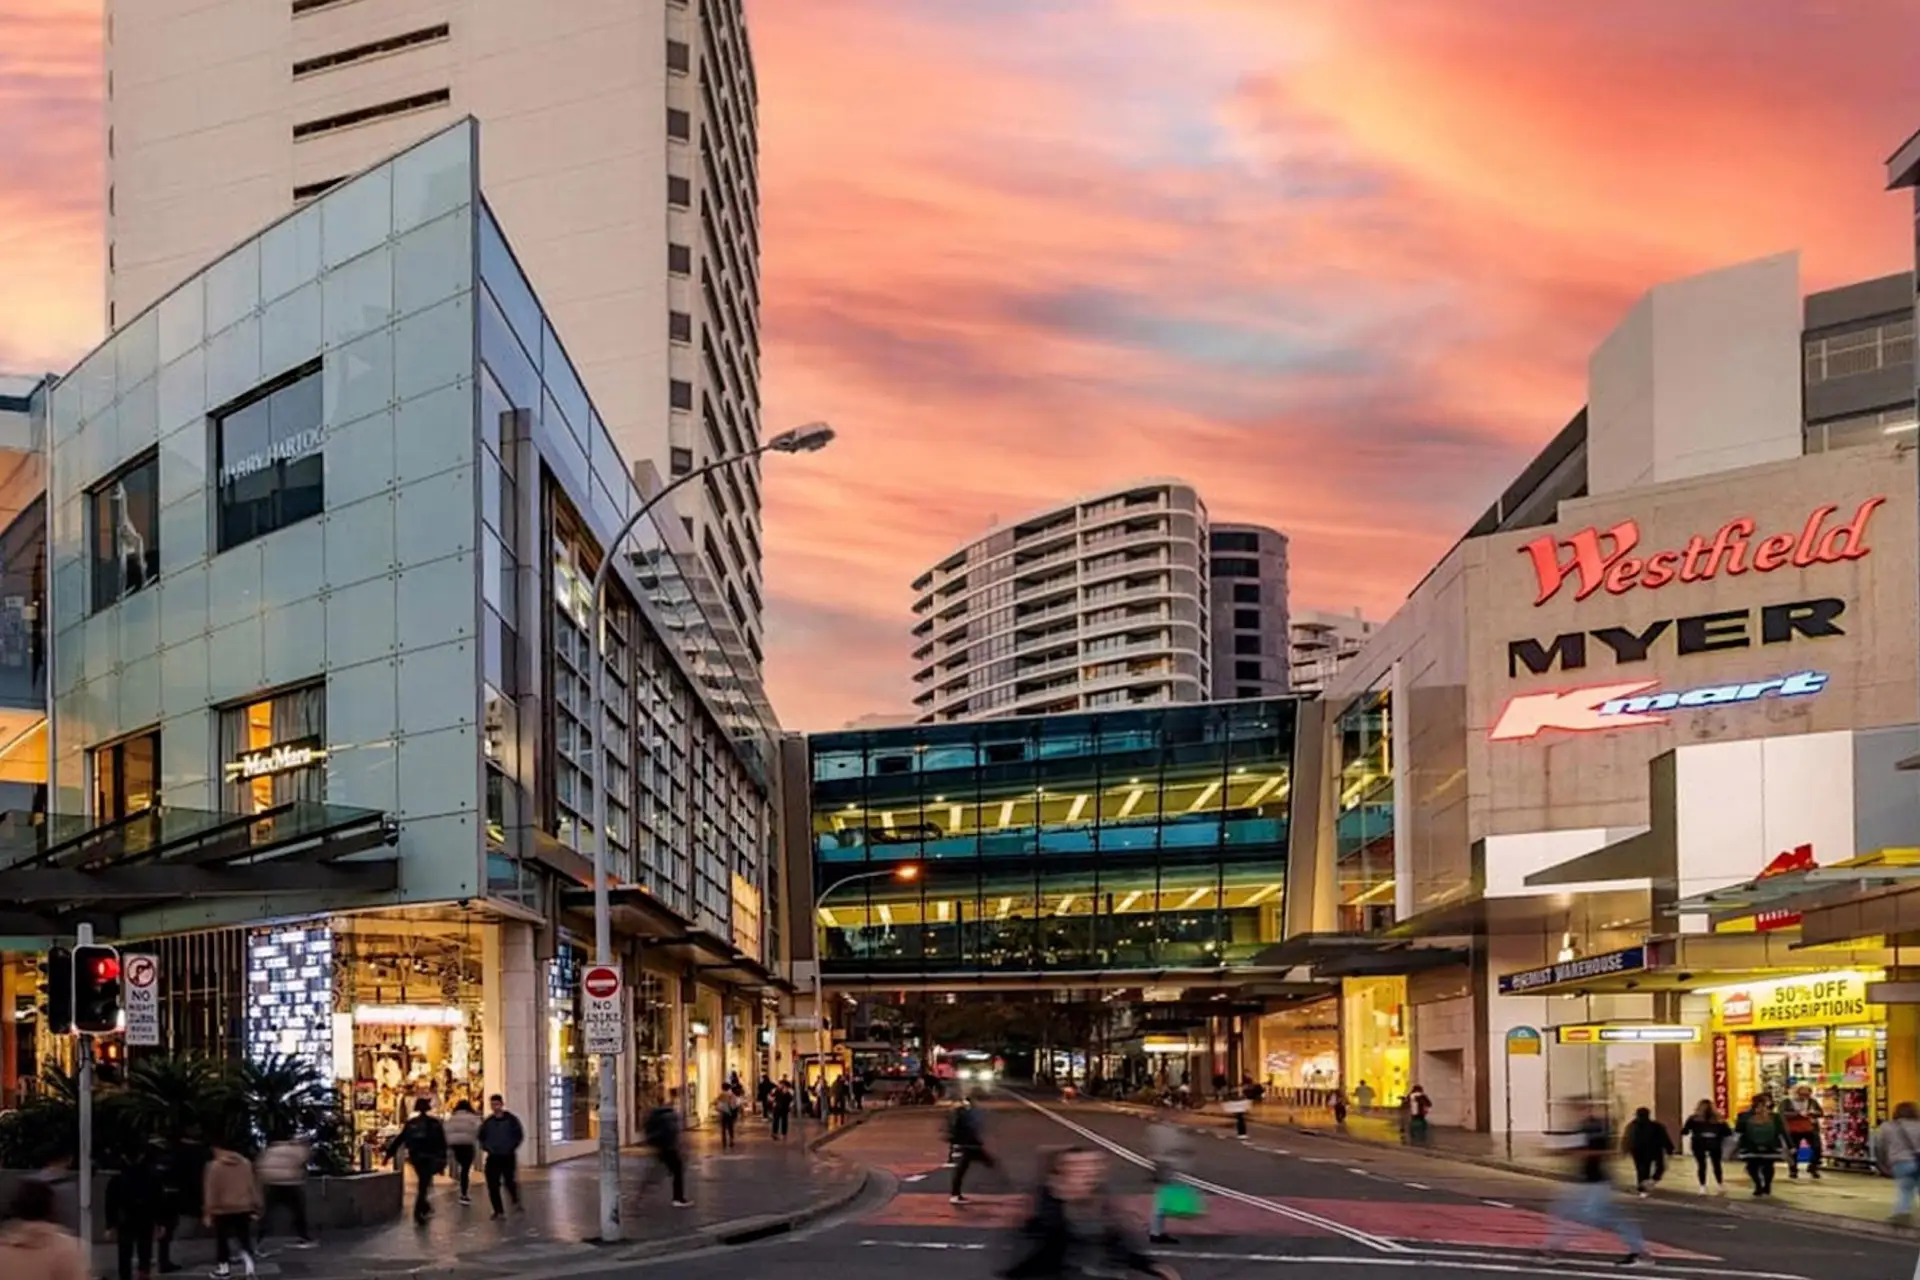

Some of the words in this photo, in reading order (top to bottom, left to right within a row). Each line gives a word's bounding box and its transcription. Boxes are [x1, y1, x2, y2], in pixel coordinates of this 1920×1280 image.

[1517, 495, 1885, 607] Westfield
[1508, 597, 1846, 678] MYER
[1488, 670, 1830, 741] Kmart
[1554, 952, 1624, 983] WAREHOUSE
[131, 990, 151, 1002] NO
[1775, 983, 1811, 1004] 50%
[1813, 979, 1848, 1000] OFF
[592, 1001, 612, 1010] NO
[1760, 998, 1864, 1021] PRESCRIPTIONS
[1715, 1070, 1727, 1083] 7
